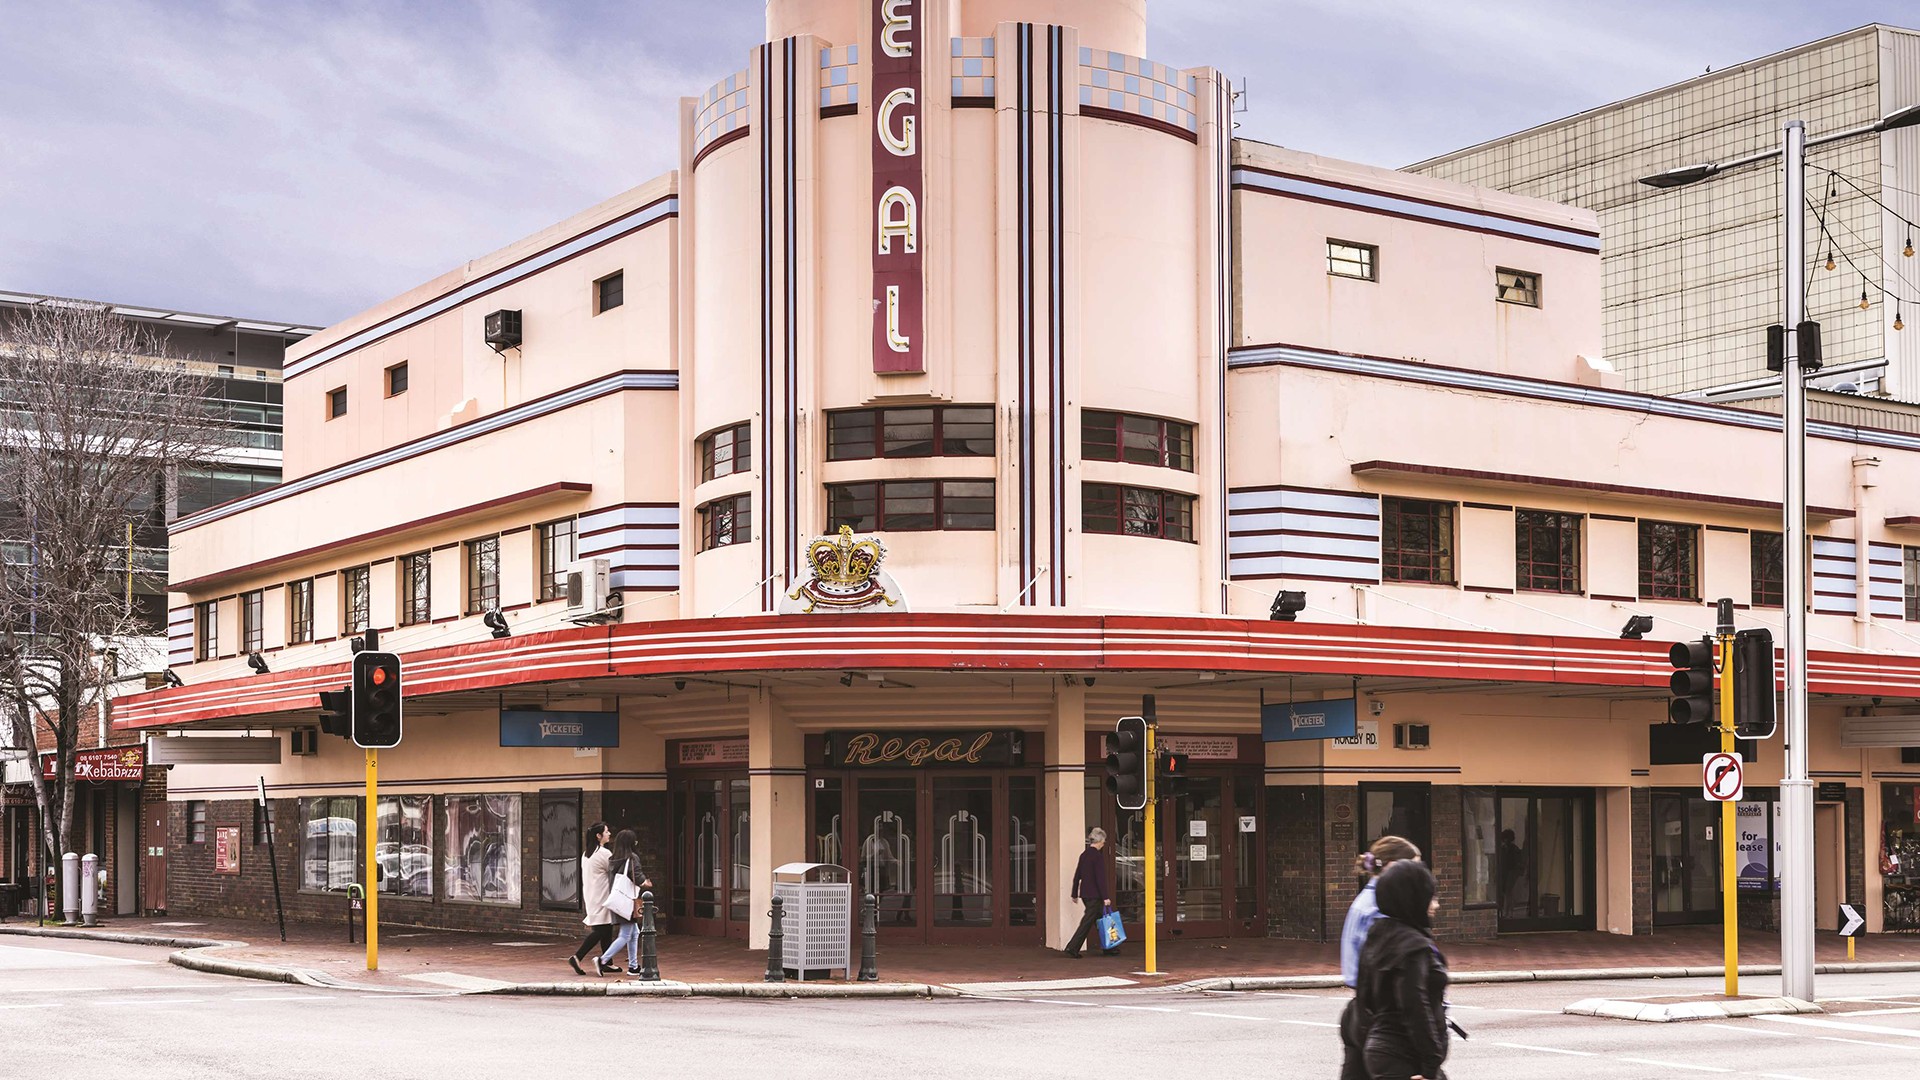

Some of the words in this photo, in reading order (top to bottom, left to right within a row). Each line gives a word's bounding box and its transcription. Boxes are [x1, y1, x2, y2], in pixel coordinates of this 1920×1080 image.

[542, 724, 582, 734] TICKETEK
[1365, 732, 1378, 745] RD.
[845, 731, 993, 766] Regal
[86, 760, 121, 777] Kebab
[120, 768, 141, 778] PIZZA
[371, 760, 377, 768] 2
[1742, 831, 1758, 841] for
[1736, 841, 1764, 852] lease
